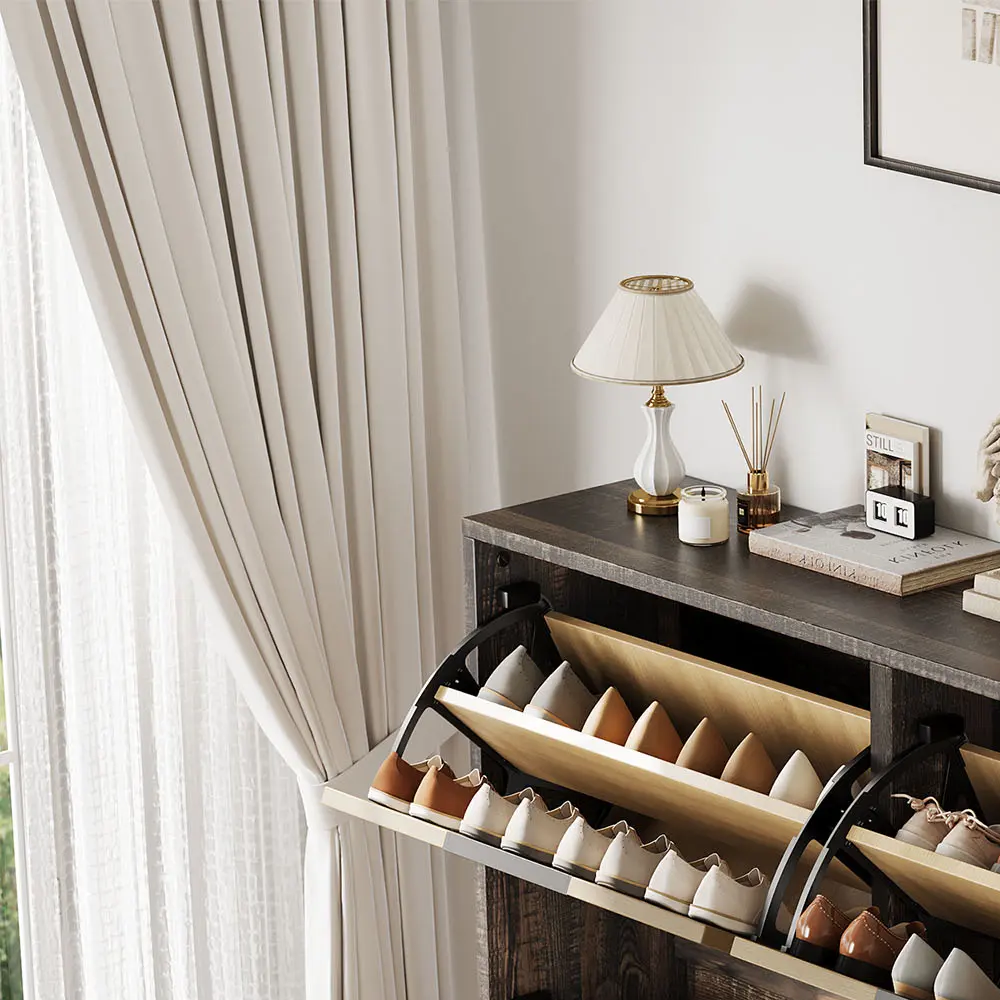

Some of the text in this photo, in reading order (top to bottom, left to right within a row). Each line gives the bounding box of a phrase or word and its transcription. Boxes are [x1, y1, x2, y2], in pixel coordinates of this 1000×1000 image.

[866, 433, 894, 452] STILL
[876, 502, 908, 525] 10 10
